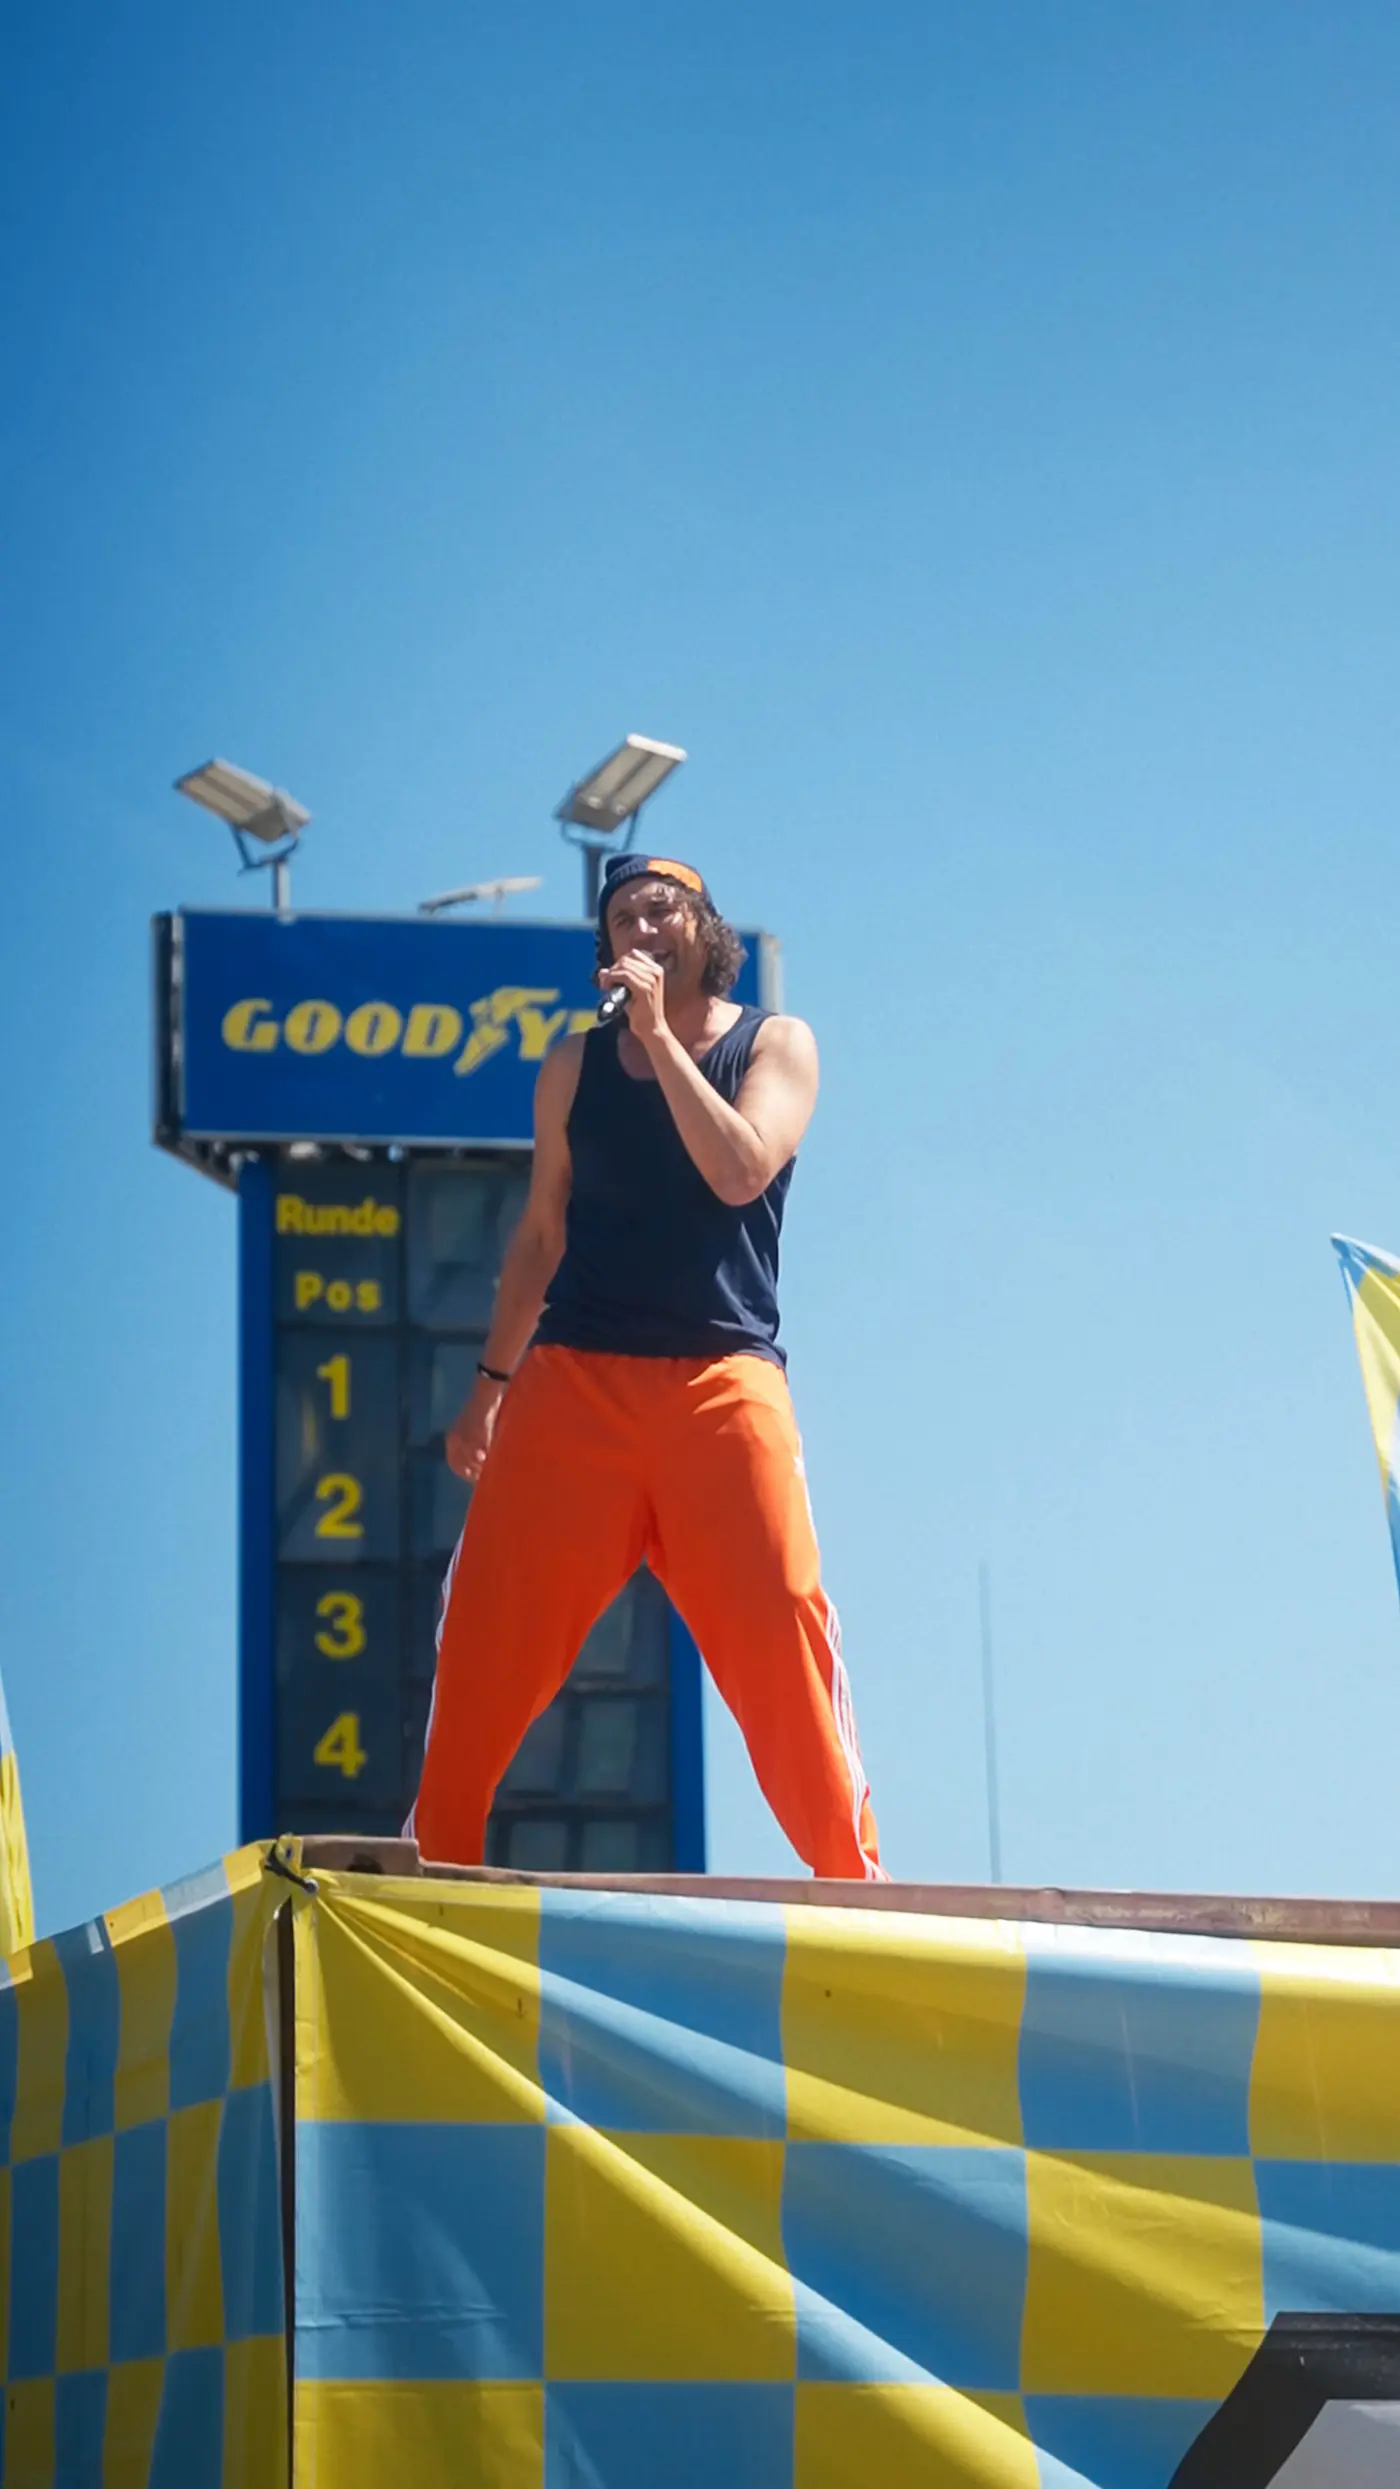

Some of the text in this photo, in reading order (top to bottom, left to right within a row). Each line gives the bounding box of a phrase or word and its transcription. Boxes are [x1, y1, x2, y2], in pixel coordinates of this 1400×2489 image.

[276, 1194, 399, 1237] Runde
[294, 1272, 380, 1310] Pos
[317, 1355, 350, 1418] 1
[315, 1473, 363, 1539] 2
[315, 1592, 366, 1658] 3
[314, 1712, 367, 1778] 4
